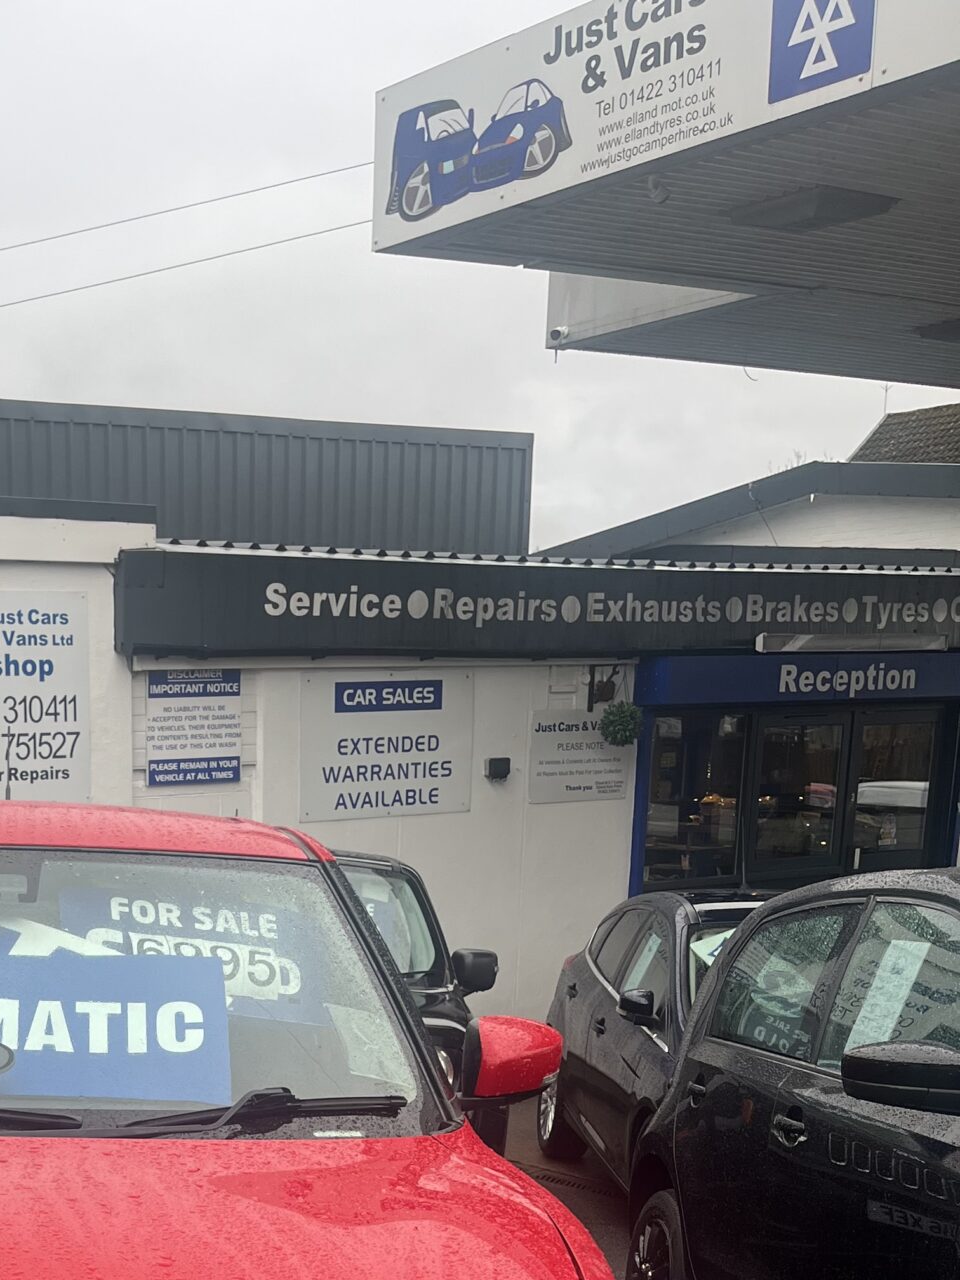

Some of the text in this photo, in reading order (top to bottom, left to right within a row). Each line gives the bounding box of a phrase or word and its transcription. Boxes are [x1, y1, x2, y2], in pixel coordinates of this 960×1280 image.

[543, 4, 618, 65] Just
[581, 23, 707, 94] & Vans
[595, 57, 722, 118] Tel 01422 310411
[598, 85, 716, 137] www.elland mot.co.uk
[596, 101, 717, 153] www.ellandtyres.co.uk
[579, 111, 734, 175] www.justgocamperhire.co.uk
[27, 608, 69, 625] Cars
[263, 582, 402, 619] Service
[432, 587, 557, 628] Repairs
[585, 591, 721, 624] Exhausts
[745, 593, 839, 623] Brakes
[862, 595, 929, 630] Tyres
[2, 630, 48, 647] Vans
[52, 634, 74, 647] Ltd
[149, 683, 239, 694] IMPORTANT NOTICE
[778, 662, 917, 698] Reception
[343, 687, 435, 706] CAR SALES
[3, 694, 78, 725] 310411
[534, 722, 557, 733] Just
[558, 721, 580, 732] Cars
[581, 721, 589, 731] &
[1, 731, 81, 761] 751527
[337, 734, 440, 756] EXTENDED
[557, 741, 605, 751] PLEASE NOTE
[7, 766, 70, 784] Repairs
[150, 760, 238, 771] PLEASE REMAIN IN YOUR
[154, 771, 233, 782] VEHICLE AT ALL TIMES
[322, 760, 453, 784] WARRANTIES
[334, 787, 439, 810] AVAILABLE
[109, 896, 279, 940] FOR SALE
